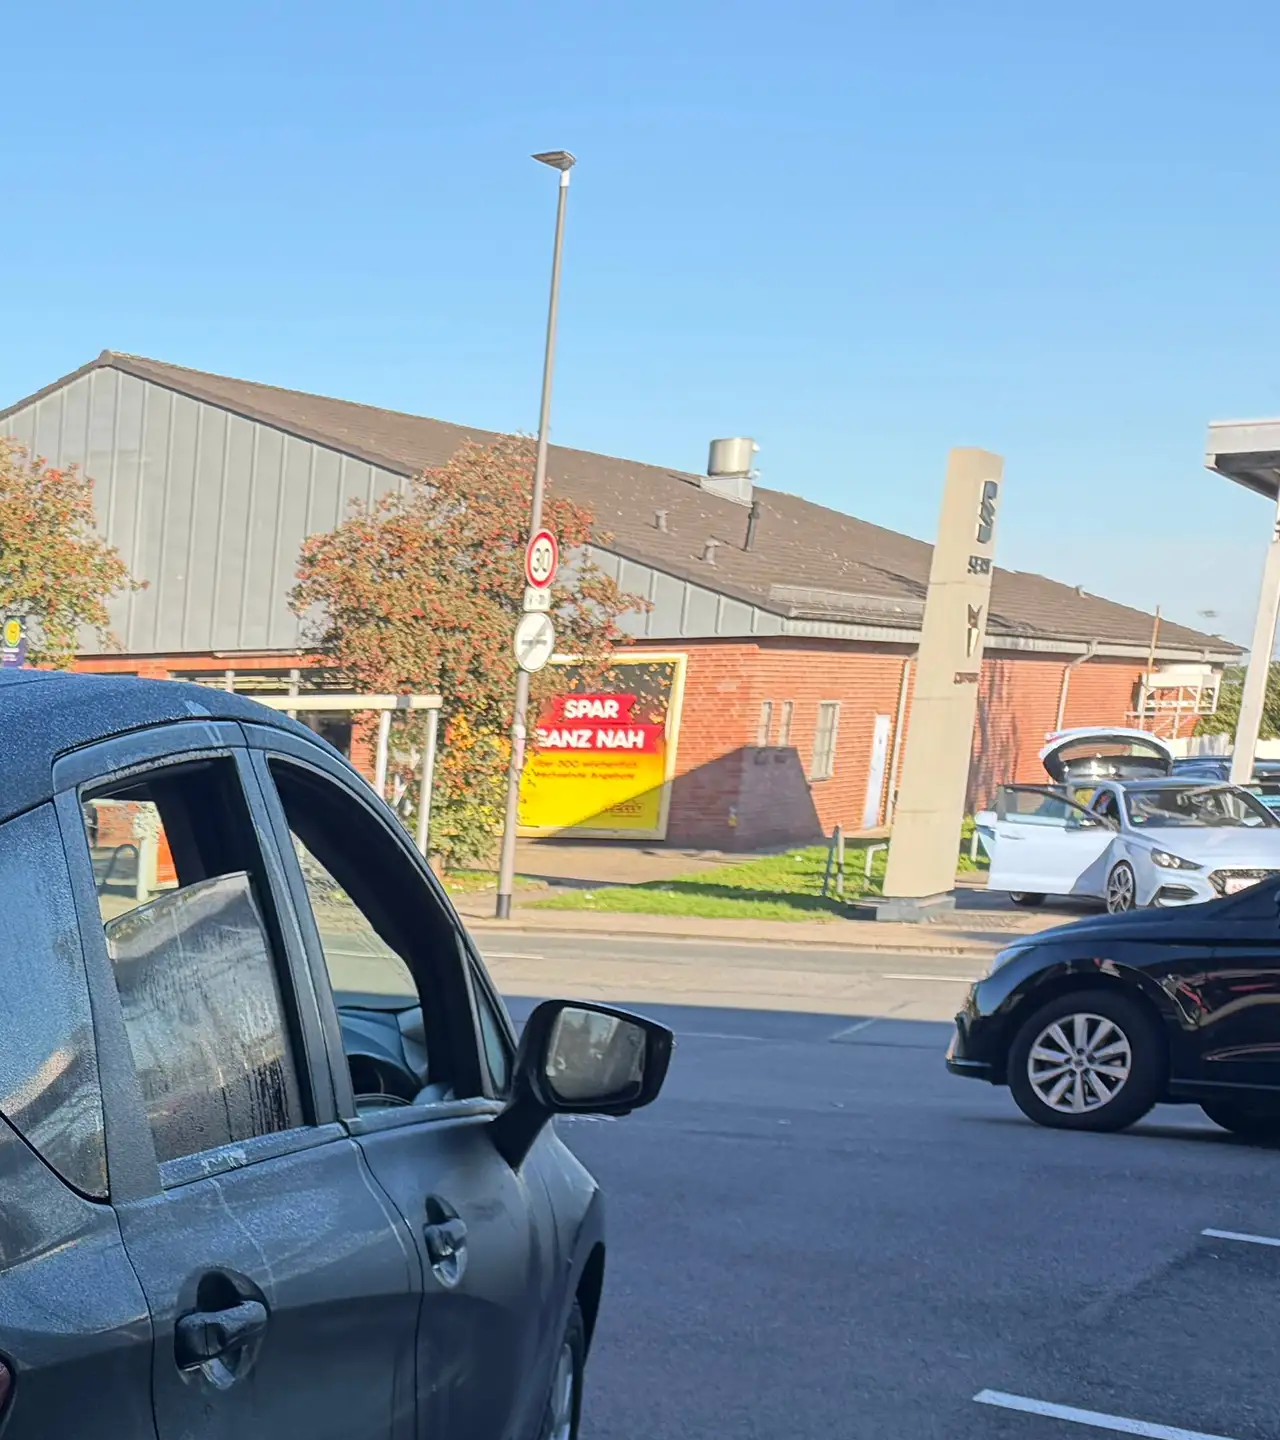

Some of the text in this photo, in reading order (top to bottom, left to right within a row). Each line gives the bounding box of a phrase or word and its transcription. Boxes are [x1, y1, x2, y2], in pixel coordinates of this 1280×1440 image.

[533, 548, 550, 573] 30
[564, 699, 620, 718] SPAR
[596, 729, 645, 749] NAH
